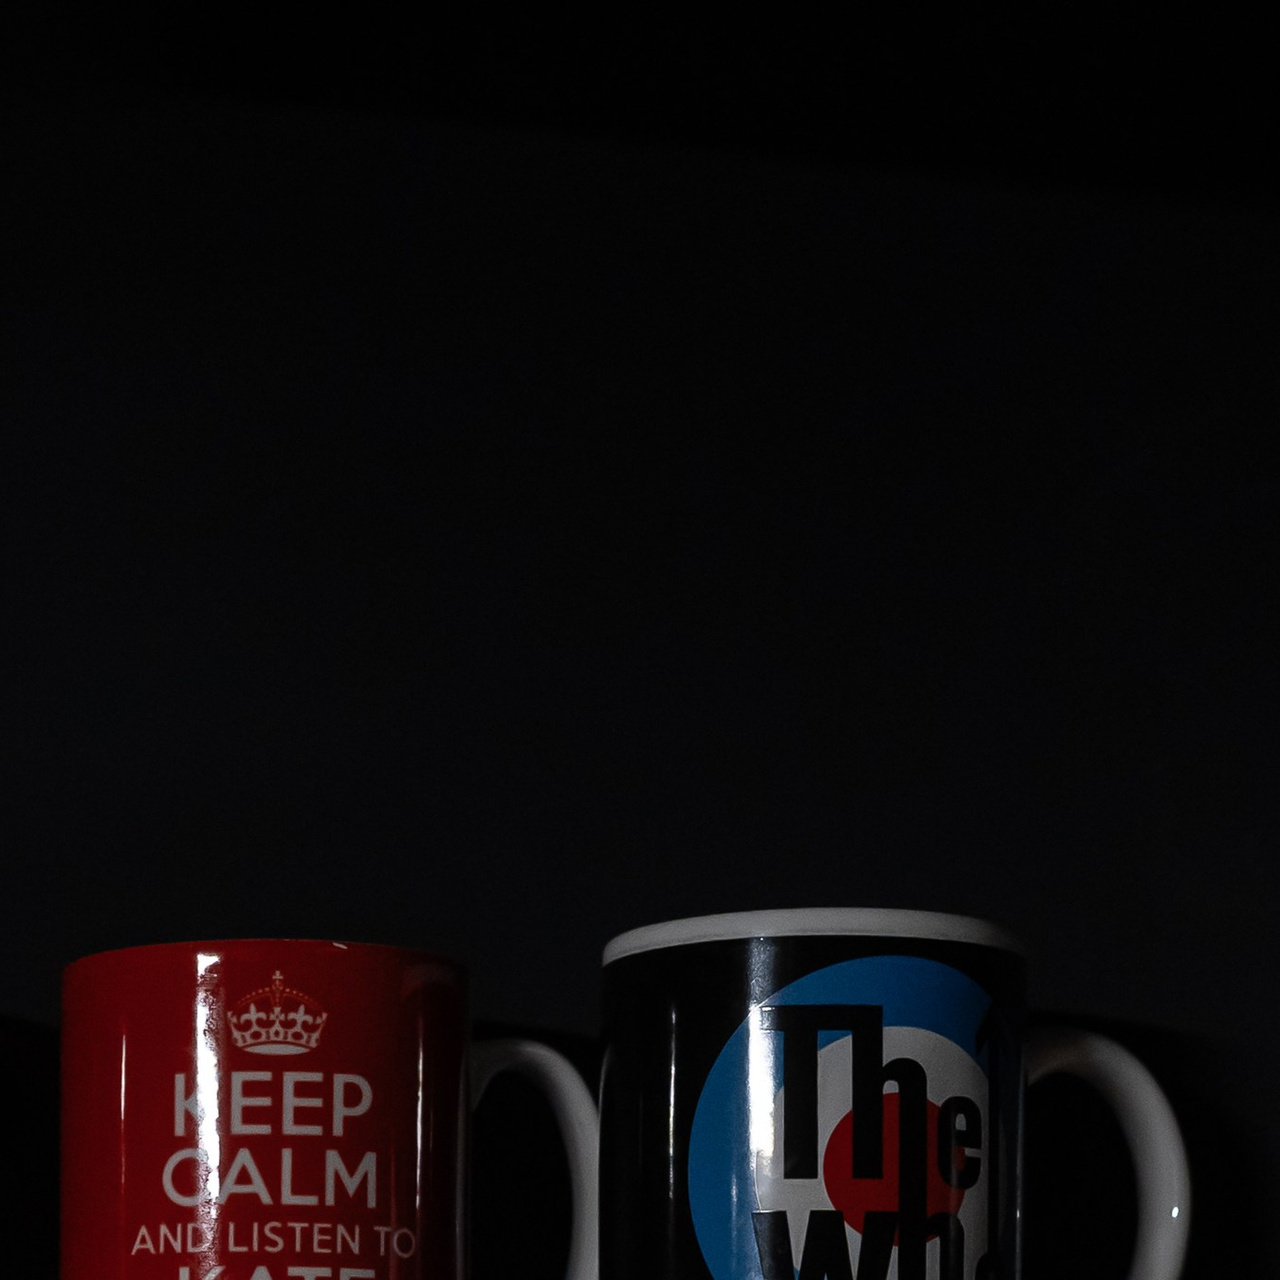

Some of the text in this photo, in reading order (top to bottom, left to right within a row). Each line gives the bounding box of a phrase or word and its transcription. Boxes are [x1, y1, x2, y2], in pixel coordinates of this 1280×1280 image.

[173, 1071, 373, 1137] KEEP
[758, 1004, 982, 1190] The
[162, 1147, 377, 1209] CALM
[131, 1221, 416, 1258] AND LISTEN TO
